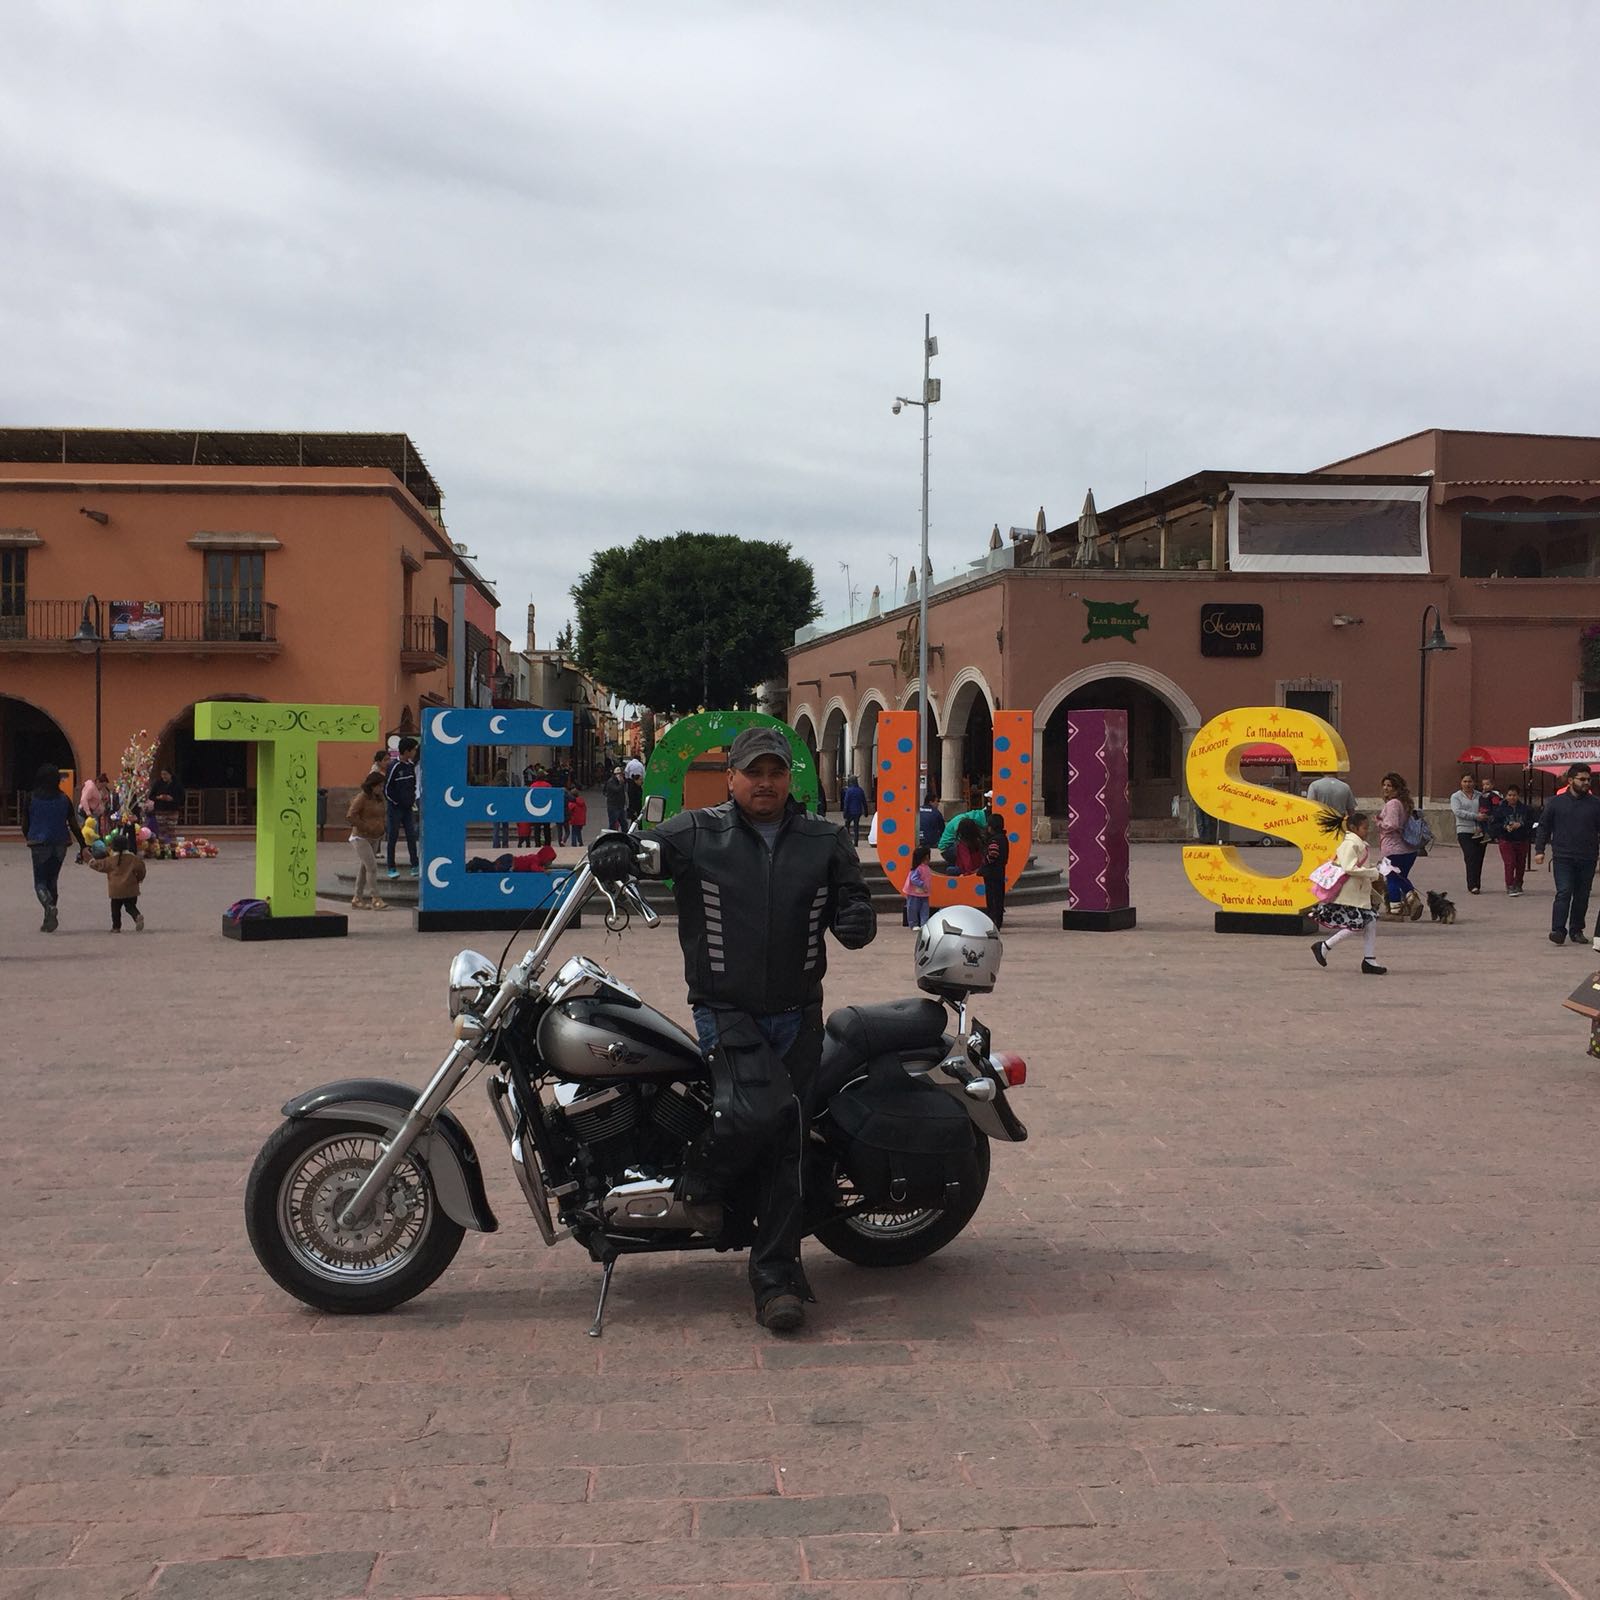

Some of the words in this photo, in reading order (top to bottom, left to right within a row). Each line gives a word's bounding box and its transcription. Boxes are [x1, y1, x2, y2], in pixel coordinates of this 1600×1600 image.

[1236, 642, 1256, 650] BAR
[1245, 725, 1256, 738] La
[1258, 726, 1304, 740] Magdalena
[1191, 750, 1198, 758] EL
[1198, 737, 1229, 755] TEJOCOTE
[1297, 757, 1318, 767] Santa
[1318, 758, 1328, 767] Fe
[1217, 783, 1252, 799] Hacienda
[1221, 892, 1245, 904] Barrio
[1246, 894, 1255, 904] de
[1257, 894, 1271, 906] San
[1272, 895, 1293, 907] Juan
